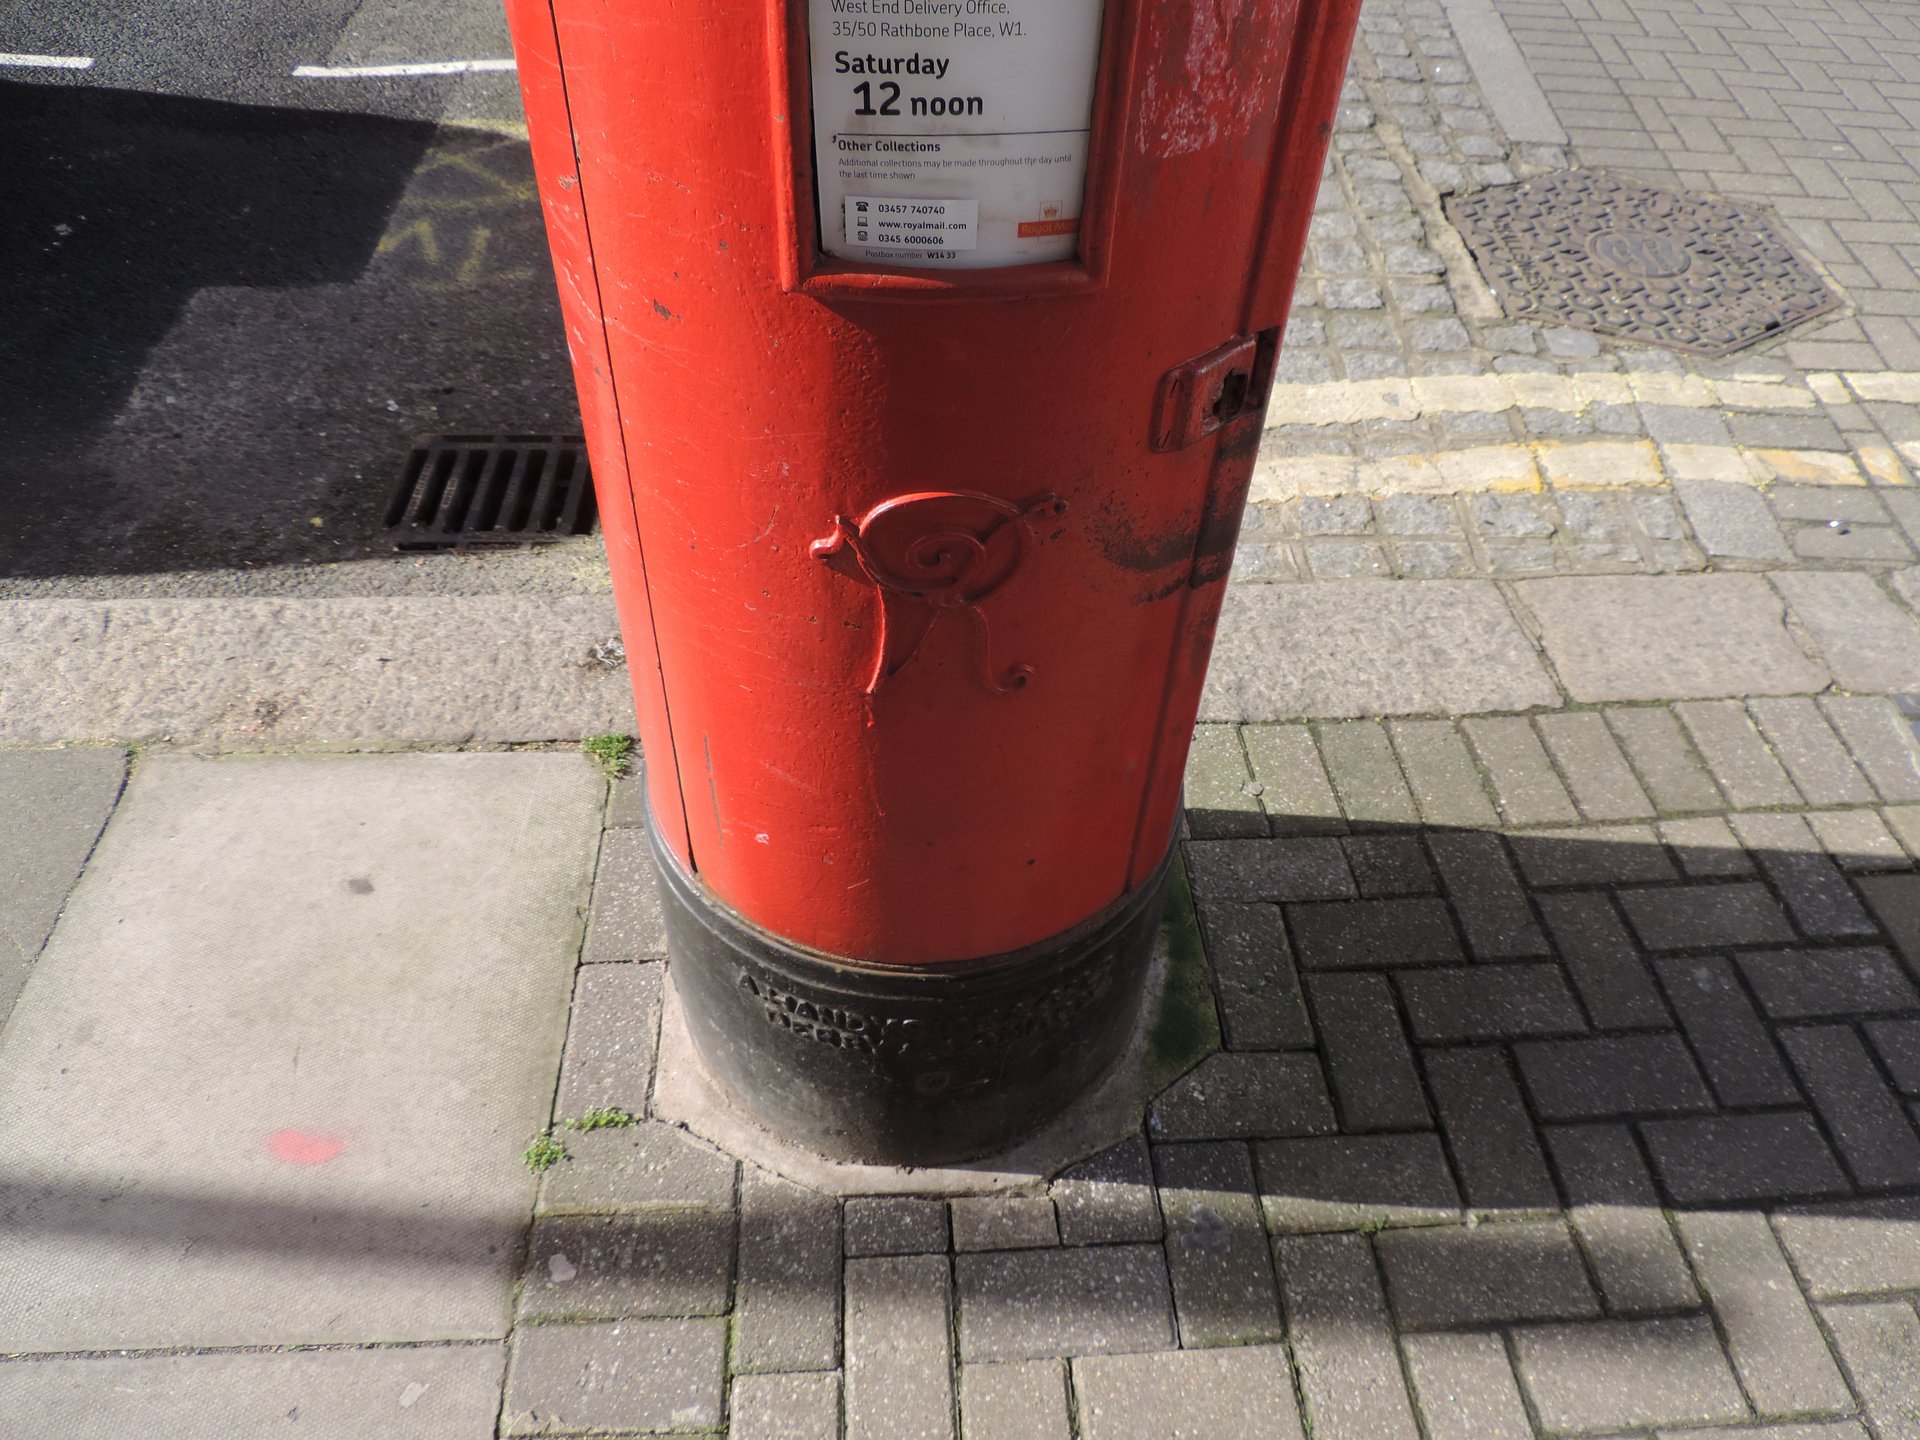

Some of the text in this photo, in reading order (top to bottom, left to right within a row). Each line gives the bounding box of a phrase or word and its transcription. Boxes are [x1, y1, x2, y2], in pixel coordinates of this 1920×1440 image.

[832, 0, 1010, 18] West End Delivery Office,
[832, 20, 1027, 38] 35/50 Rathbone Place, W1.
[834, 51, 950, 79] Saturday
[853, 81, 984, 116] 12 noon
[838, 140, 941, 152] Other Collections
[839, 154, 1072, 169] Additional collections may be made throughout the day until
[839, 170, 852, 178] the
[853, 170, 868, 179] last
[869, 170, 888, 179] time
[878, 204, 945, 215] 03457 740740
[878, 220, 967, 231] www.royalmail.com
[878, 234, 944, 245] 0345 6000606
[865, 250, 894, 258] Postbox
[895, 252, 923, 260] number
